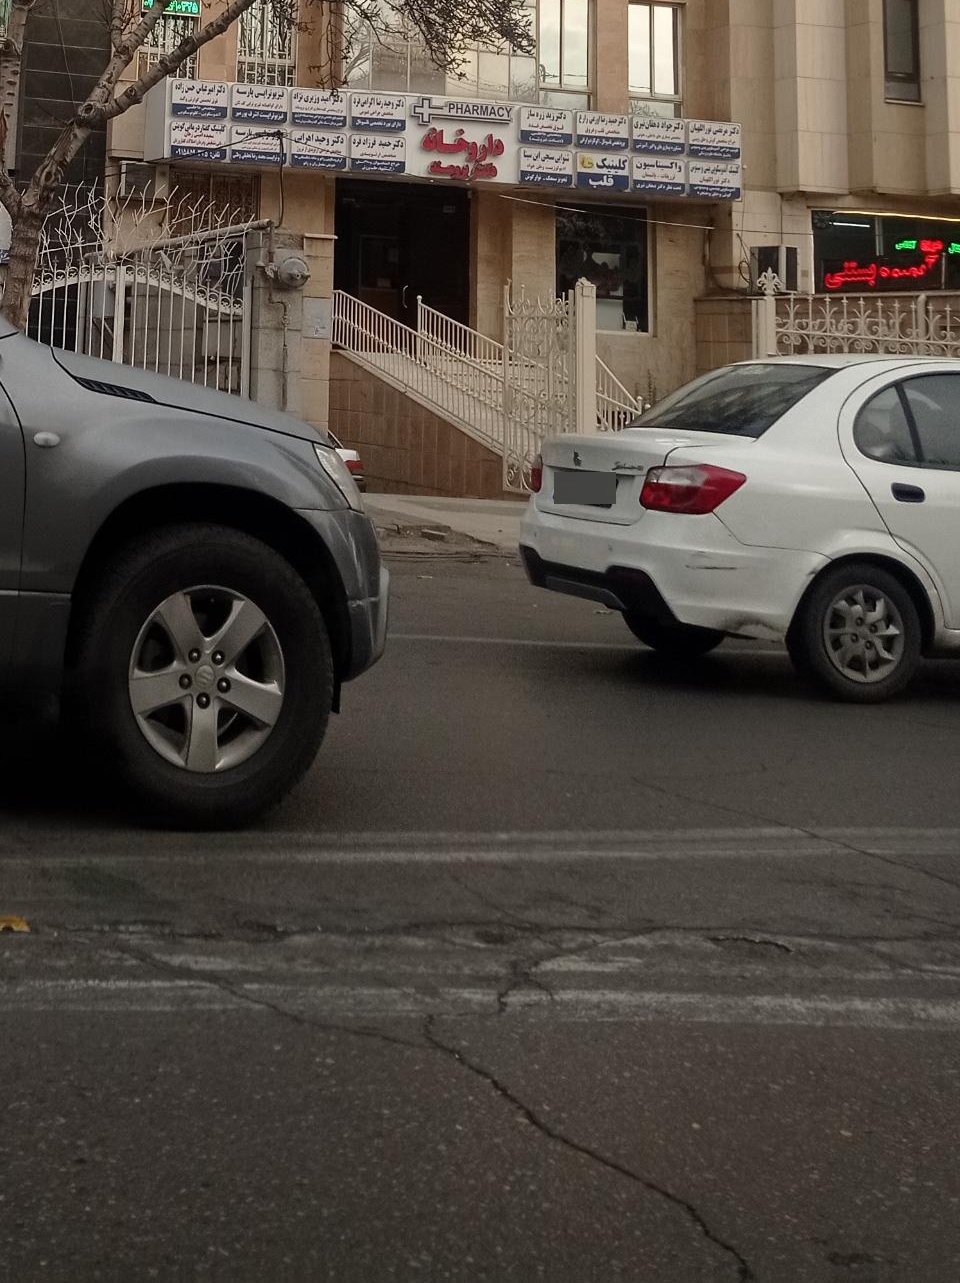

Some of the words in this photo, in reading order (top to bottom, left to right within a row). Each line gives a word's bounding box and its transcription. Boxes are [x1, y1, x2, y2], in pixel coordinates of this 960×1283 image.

[216, 85, 225, 96] دکتر
[236, 87, 254, 98] پارسه
[255, 89, 284, 100] فیزیوتراپی
[395, 99, 404, 109] دکتر
[448, 103, 512, 118] PHARMACY
[555, 112, 566, 121] دکتر
[618, 117, 626, 126] دکتر
[673, 122, 683, 132] دکتر
[729, 126, 739, 136] دکتر
[331, 136, 344, 146] دکتر
[392, 140, 403, 150] دکتر
[422, 126, 504, 163] داروخانه
[596, 158, 627, 174] کلینیک
[636, 160, 681, 172] واکسیناسیون
[589, 174, 614, 188] قلب
